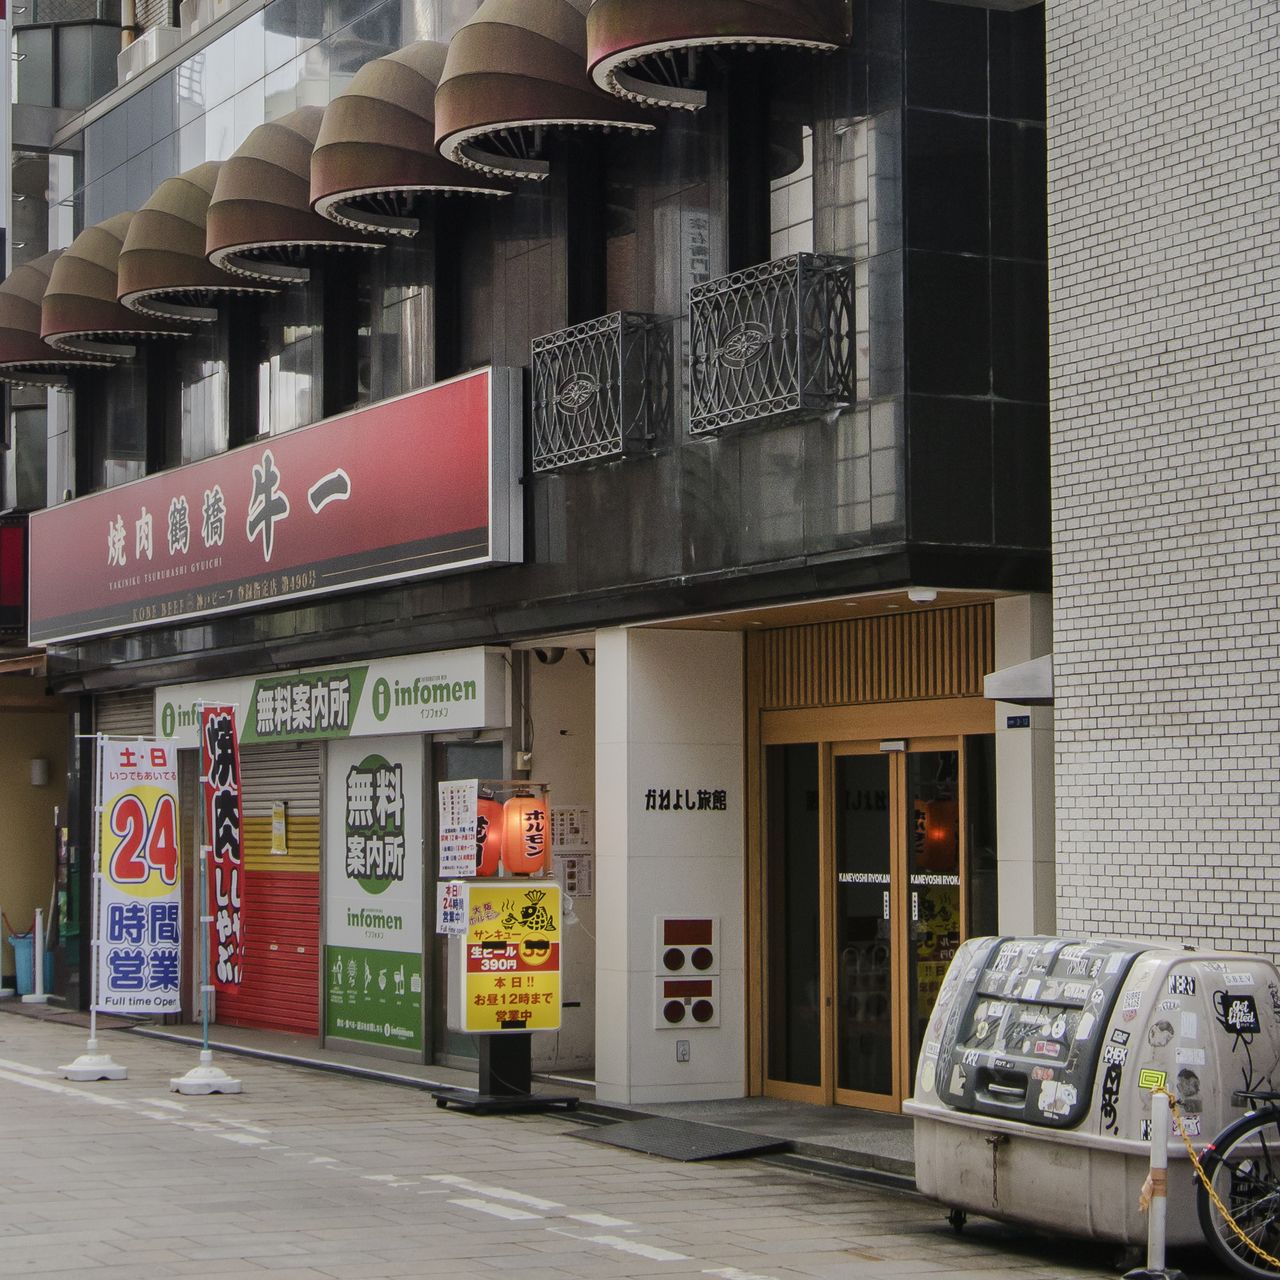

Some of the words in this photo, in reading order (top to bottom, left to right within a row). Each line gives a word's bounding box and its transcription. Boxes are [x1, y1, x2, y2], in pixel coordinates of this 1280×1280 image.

[394, 677, 476, 706] infomen
[256, 677, 351, 735] 無料案内所
[109, 770, 177, 782] いつでもあいてる
[347, 764, 405, 829] 無料
[645, 788, 727, 811] かねよし旅館
[108, 793, 178, 886] 24
[523, 809, 545, 858] ホルモン
[346, 834, 405, 881] 案内所
[838, 872, 867, 883] KANEYOSHI
[868, 873, 890, 883] RYOKAN
[910, 874, 942, 884] KANEYOSHI
[442, 897, 464, 911] 24時間
[107, 901, 179, 946] 時間
[347, 907, 403, 930] infomen
[473, 930, 521, 940] サンキュー
[471, 946, 517, 960] 生ビール
[108, 946, 180, 993] 営業
[481, 959, 517, 971] 390円
[105, 997, 125, 1007] Full
[128, 997, 152, 1006] time
[474, 992, 553, 1006] お昼12時まで
[495, 1009, 533, 1022] 営業中
